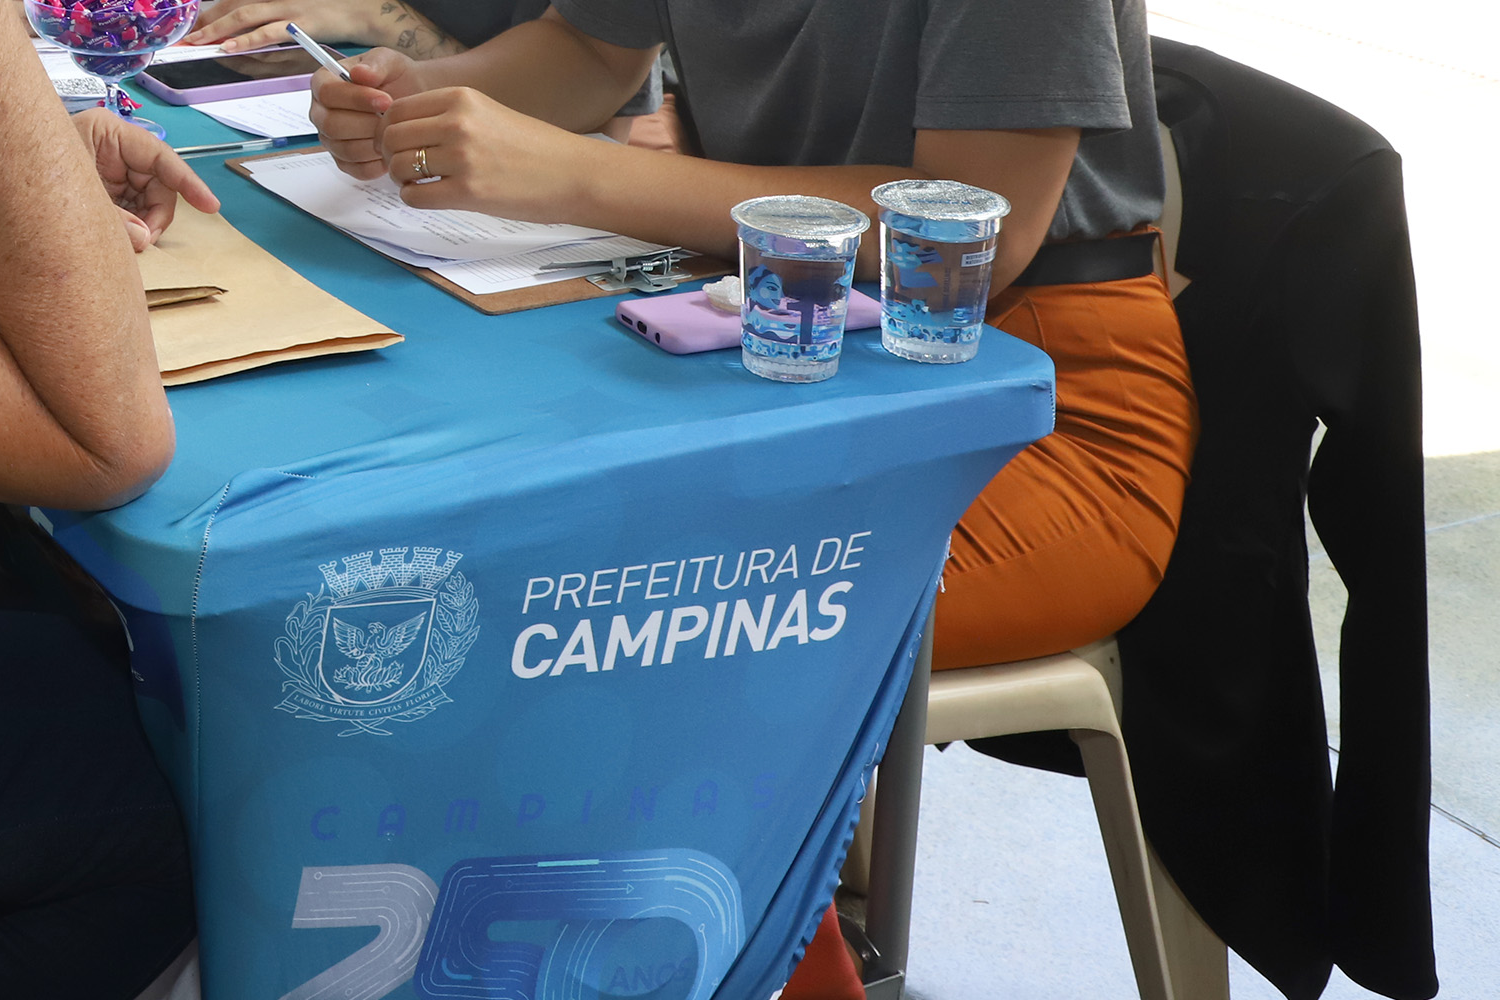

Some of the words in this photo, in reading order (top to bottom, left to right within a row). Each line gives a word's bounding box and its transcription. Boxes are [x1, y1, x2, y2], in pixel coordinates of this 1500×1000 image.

[521, 544, 799, 615] PREFEITURA
[810, 530, 872, 576] DE
[511, 580, 854, 680] CAMPINAS
[293, 693, 326, 711] LABORE
[329, 706, 365, 717] VIRTUTE
[368, 703, 402, 716] CIVITAS
[405, 687, 437, 708] FLORET
